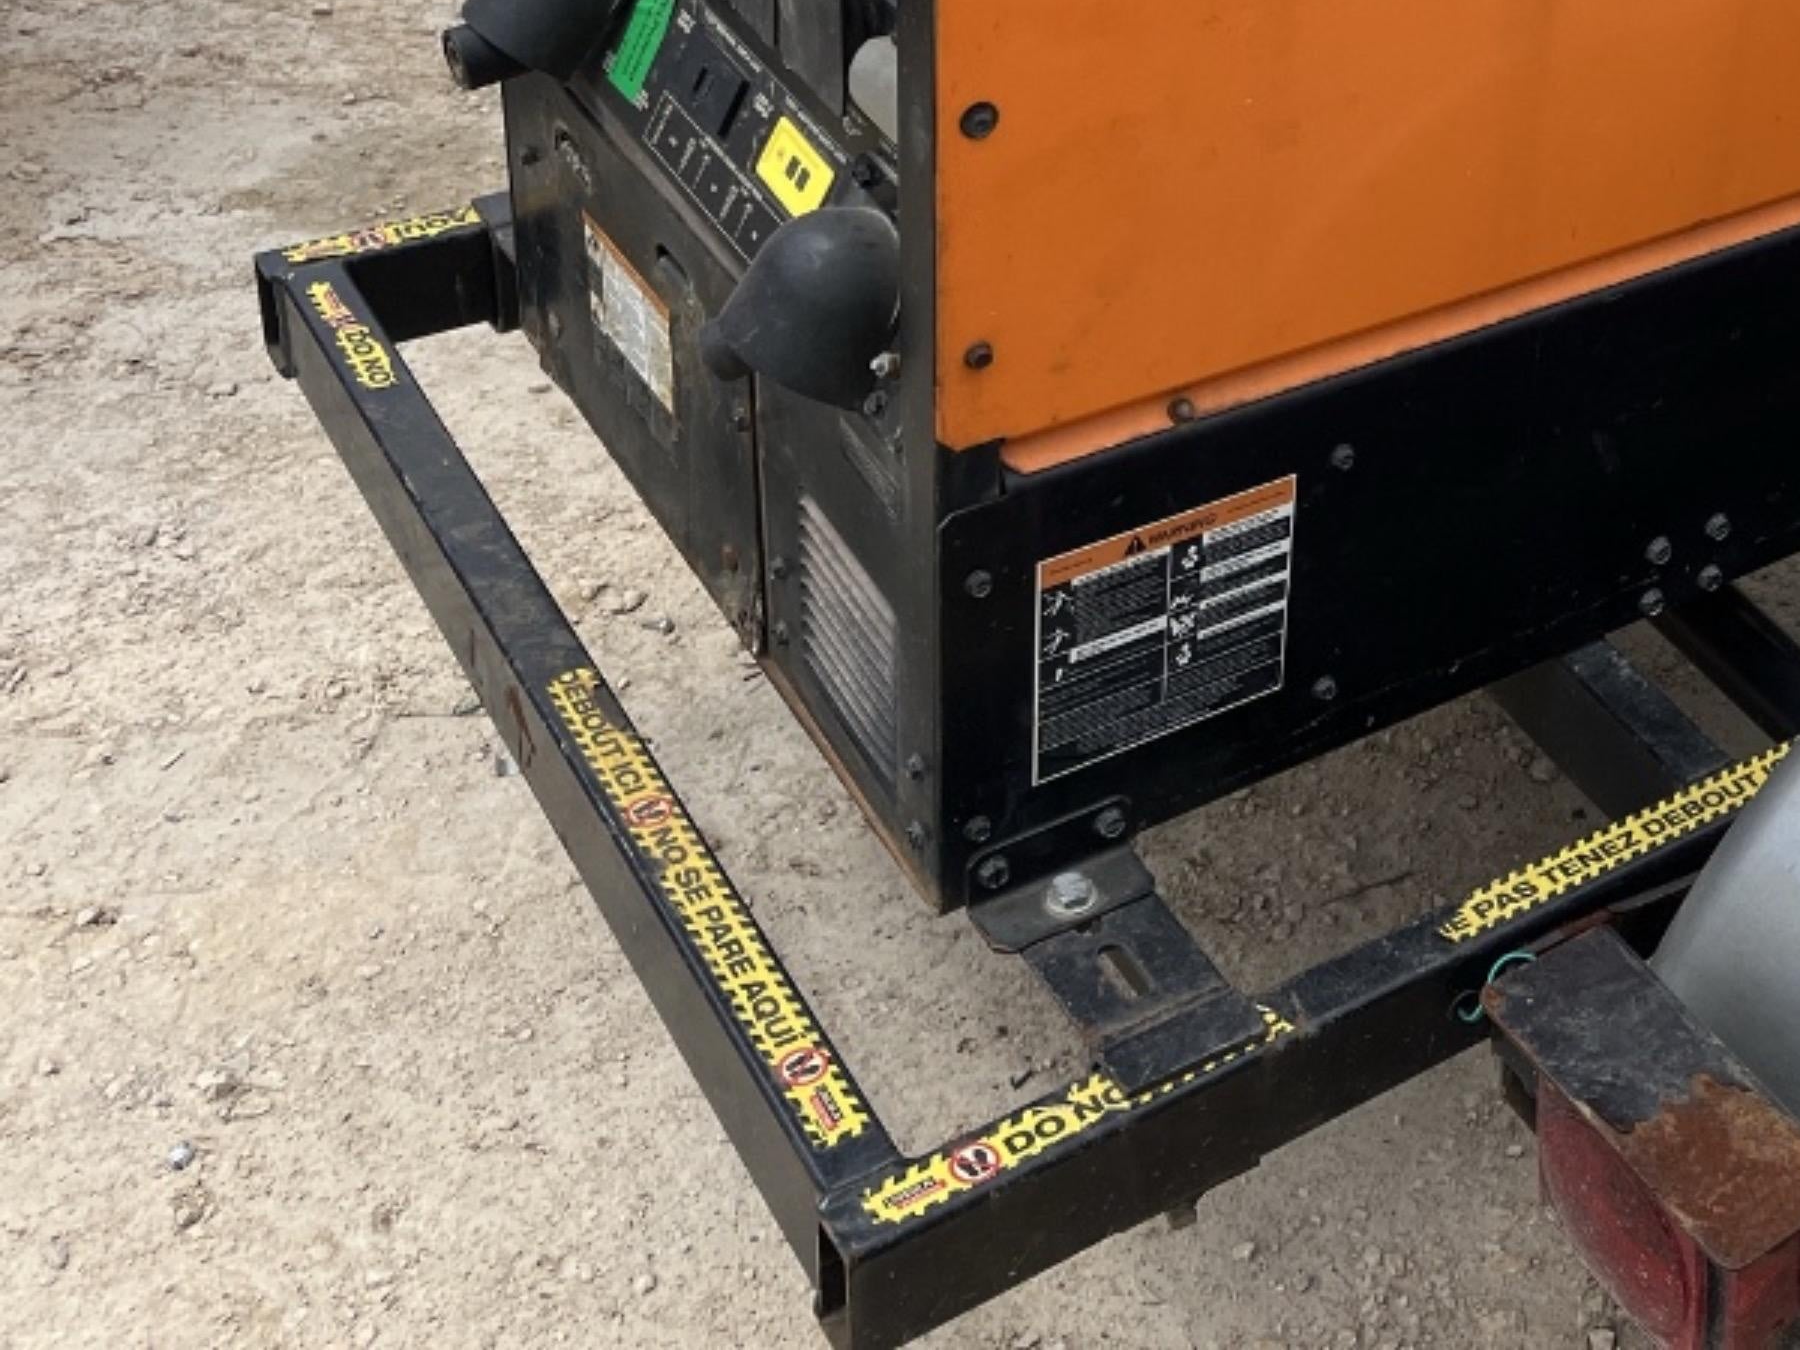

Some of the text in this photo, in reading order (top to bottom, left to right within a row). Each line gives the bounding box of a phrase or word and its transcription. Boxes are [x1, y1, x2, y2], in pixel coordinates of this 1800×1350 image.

[609, 760, 648, 796] ICI
[1472, 883, 1540, 918] PAS
[1539, 829, 1641, 886] TENEZ
[1642, 771, 1758, 838] DEBOUT
[650, 826, 688, 864] NO
[675, 867, 712, 906] SE
[697, 905, 757, 978] PARE
[1003, 1115, 1065, 1155] DO
